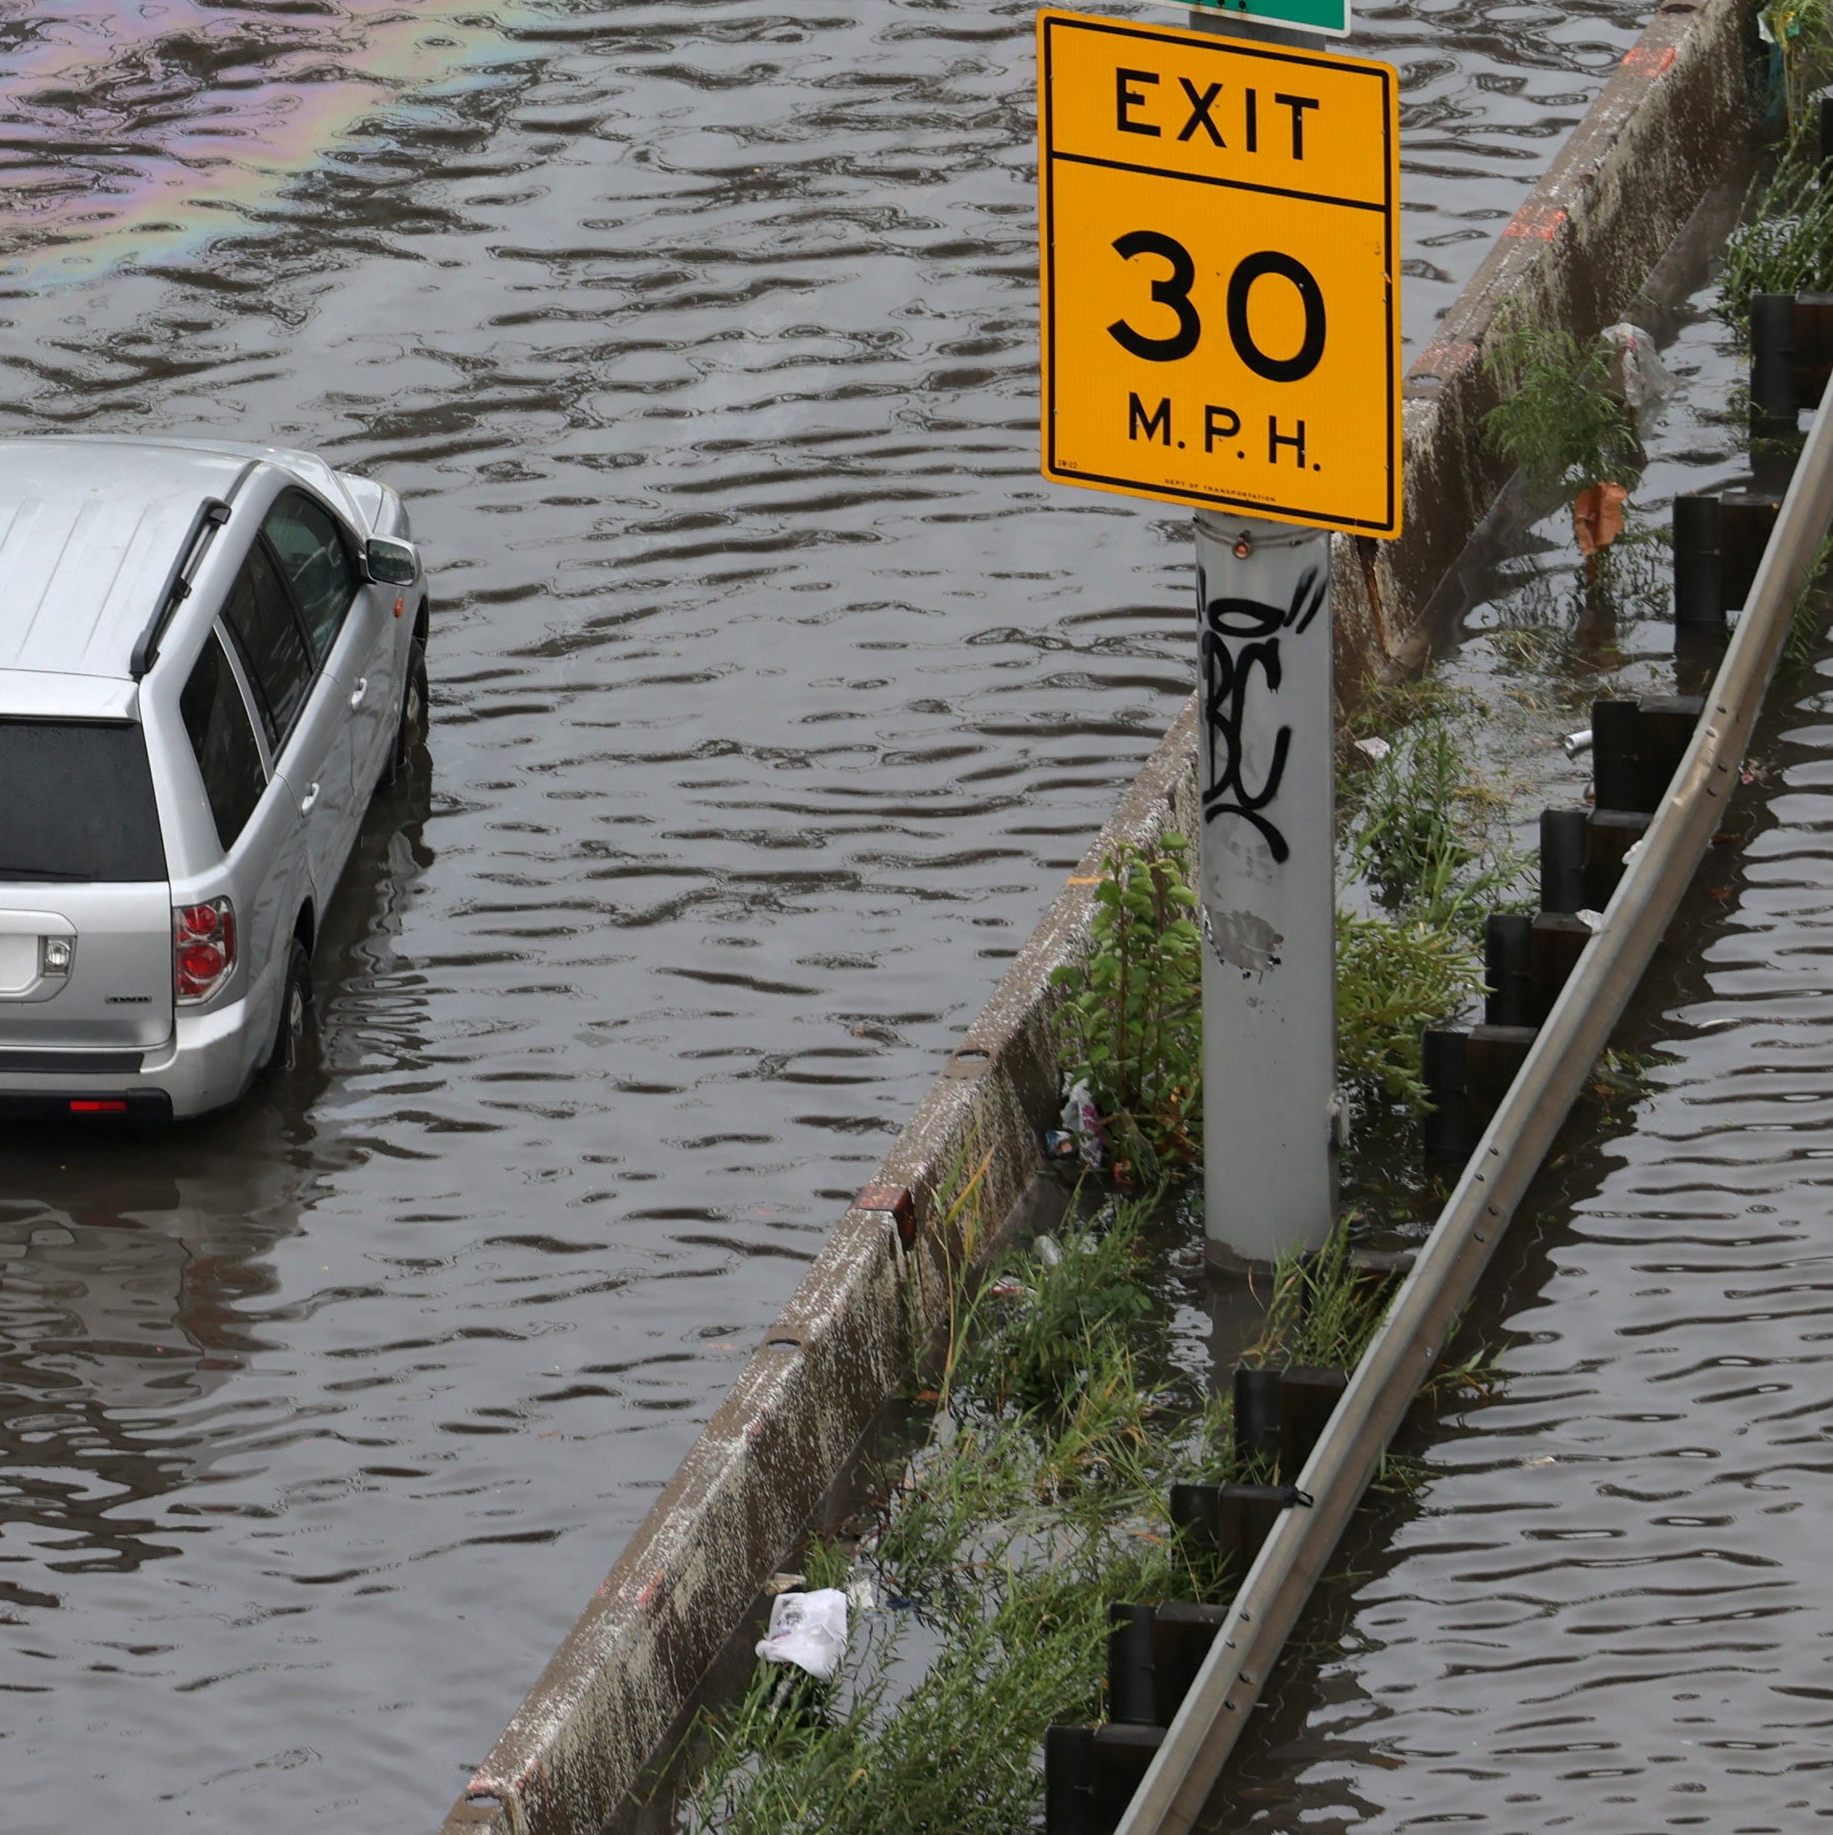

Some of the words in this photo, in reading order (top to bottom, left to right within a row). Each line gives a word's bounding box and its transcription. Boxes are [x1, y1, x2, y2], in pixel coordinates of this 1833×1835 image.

[1116, 67, 1319, 161] EXIT
[1107, 230, 1327, 383] 30
[1129, 392, 1322, 473] M.P.H.
